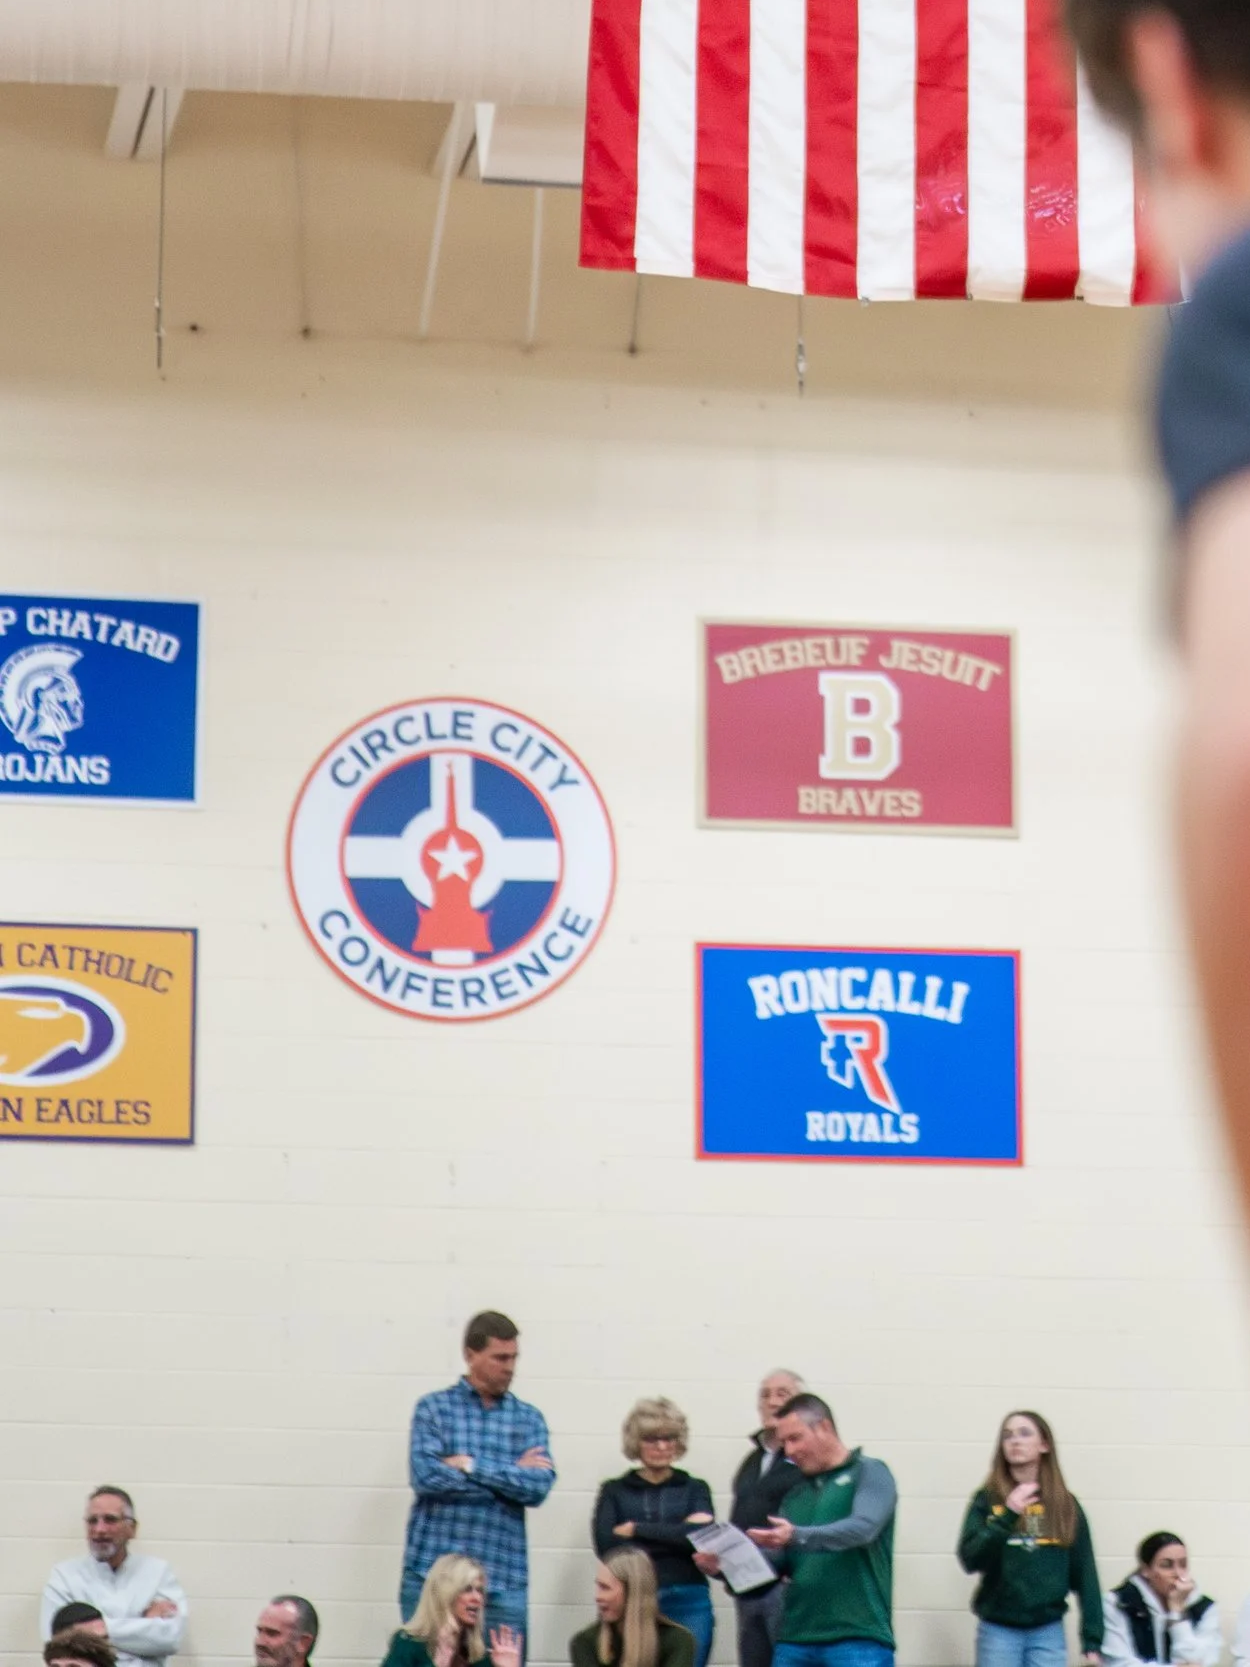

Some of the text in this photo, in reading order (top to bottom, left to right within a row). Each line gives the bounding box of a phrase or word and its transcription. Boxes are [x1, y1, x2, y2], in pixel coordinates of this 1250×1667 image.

[26, 607, 182, 664] CHATARD
[714, 636, 1002, 692] BREBEUF JESUIT
[329, 710, 580, 792] CIRCLE CITY
[818, 669, 902, 781] B
[0, 752, 110, 785] OJANS
[797, 786, 922, 818] BRAVES
[17, 942, 173, 994] CATHOLIC
[318, 906, 593, 1009] CONFERENCE
[747, 966, 971, 1025] RONCALLI
[35, 1097, 152, 1126] EAGLES
[805, 1110, 920, 1144] ROYALS
